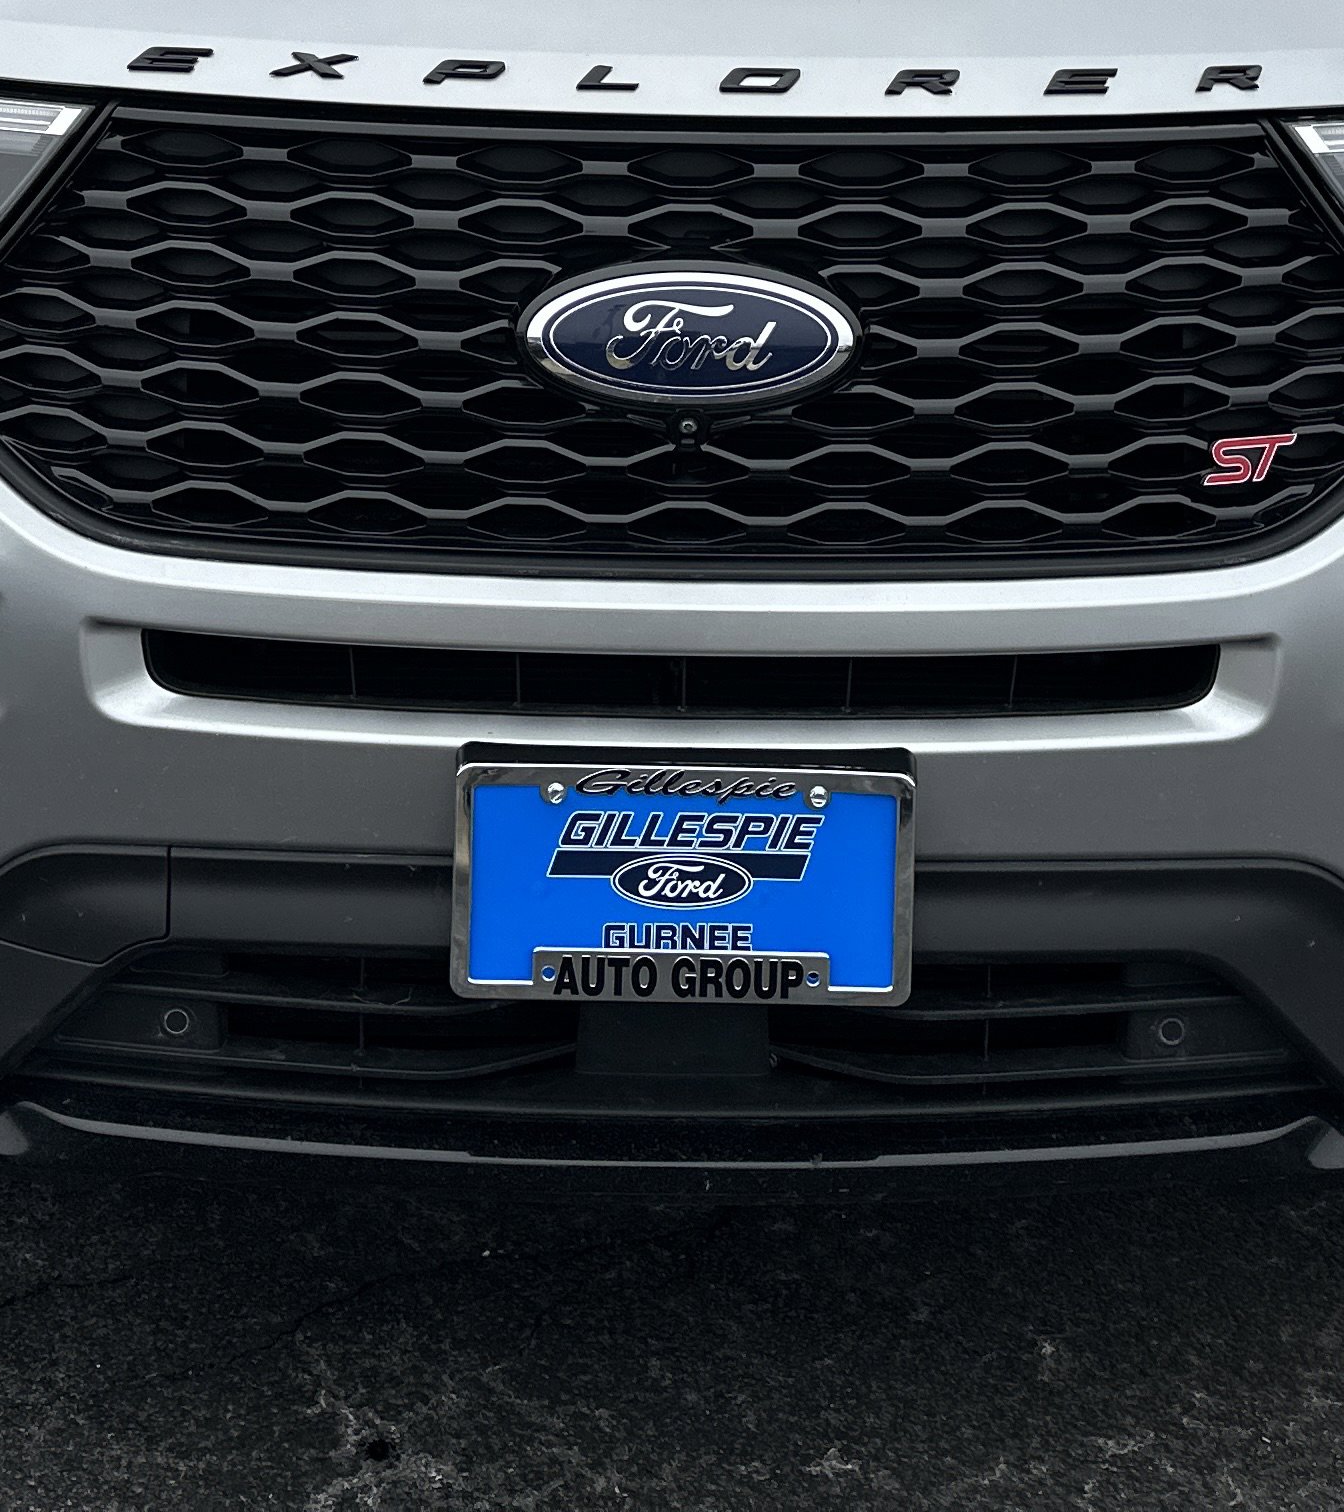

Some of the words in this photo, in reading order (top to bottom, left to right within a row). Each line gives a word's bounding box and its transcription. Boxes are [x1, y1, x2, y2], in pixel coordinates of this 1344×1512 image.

[126, 46, 1263, 96] EXPLORER
[605, 299, 774, 372] Ford
[1203, 433, 1297, 486] ST
[575, 768, 797, 804] Gillespie
[558, 810, 825, 852] GILLESPIE
[638, 862, 723, 899] Ford
[602, 921, 754, 951] GURNEE
[554, 954, 658, 997] AUTO
[670, 958, 805, 1000] GROUP
